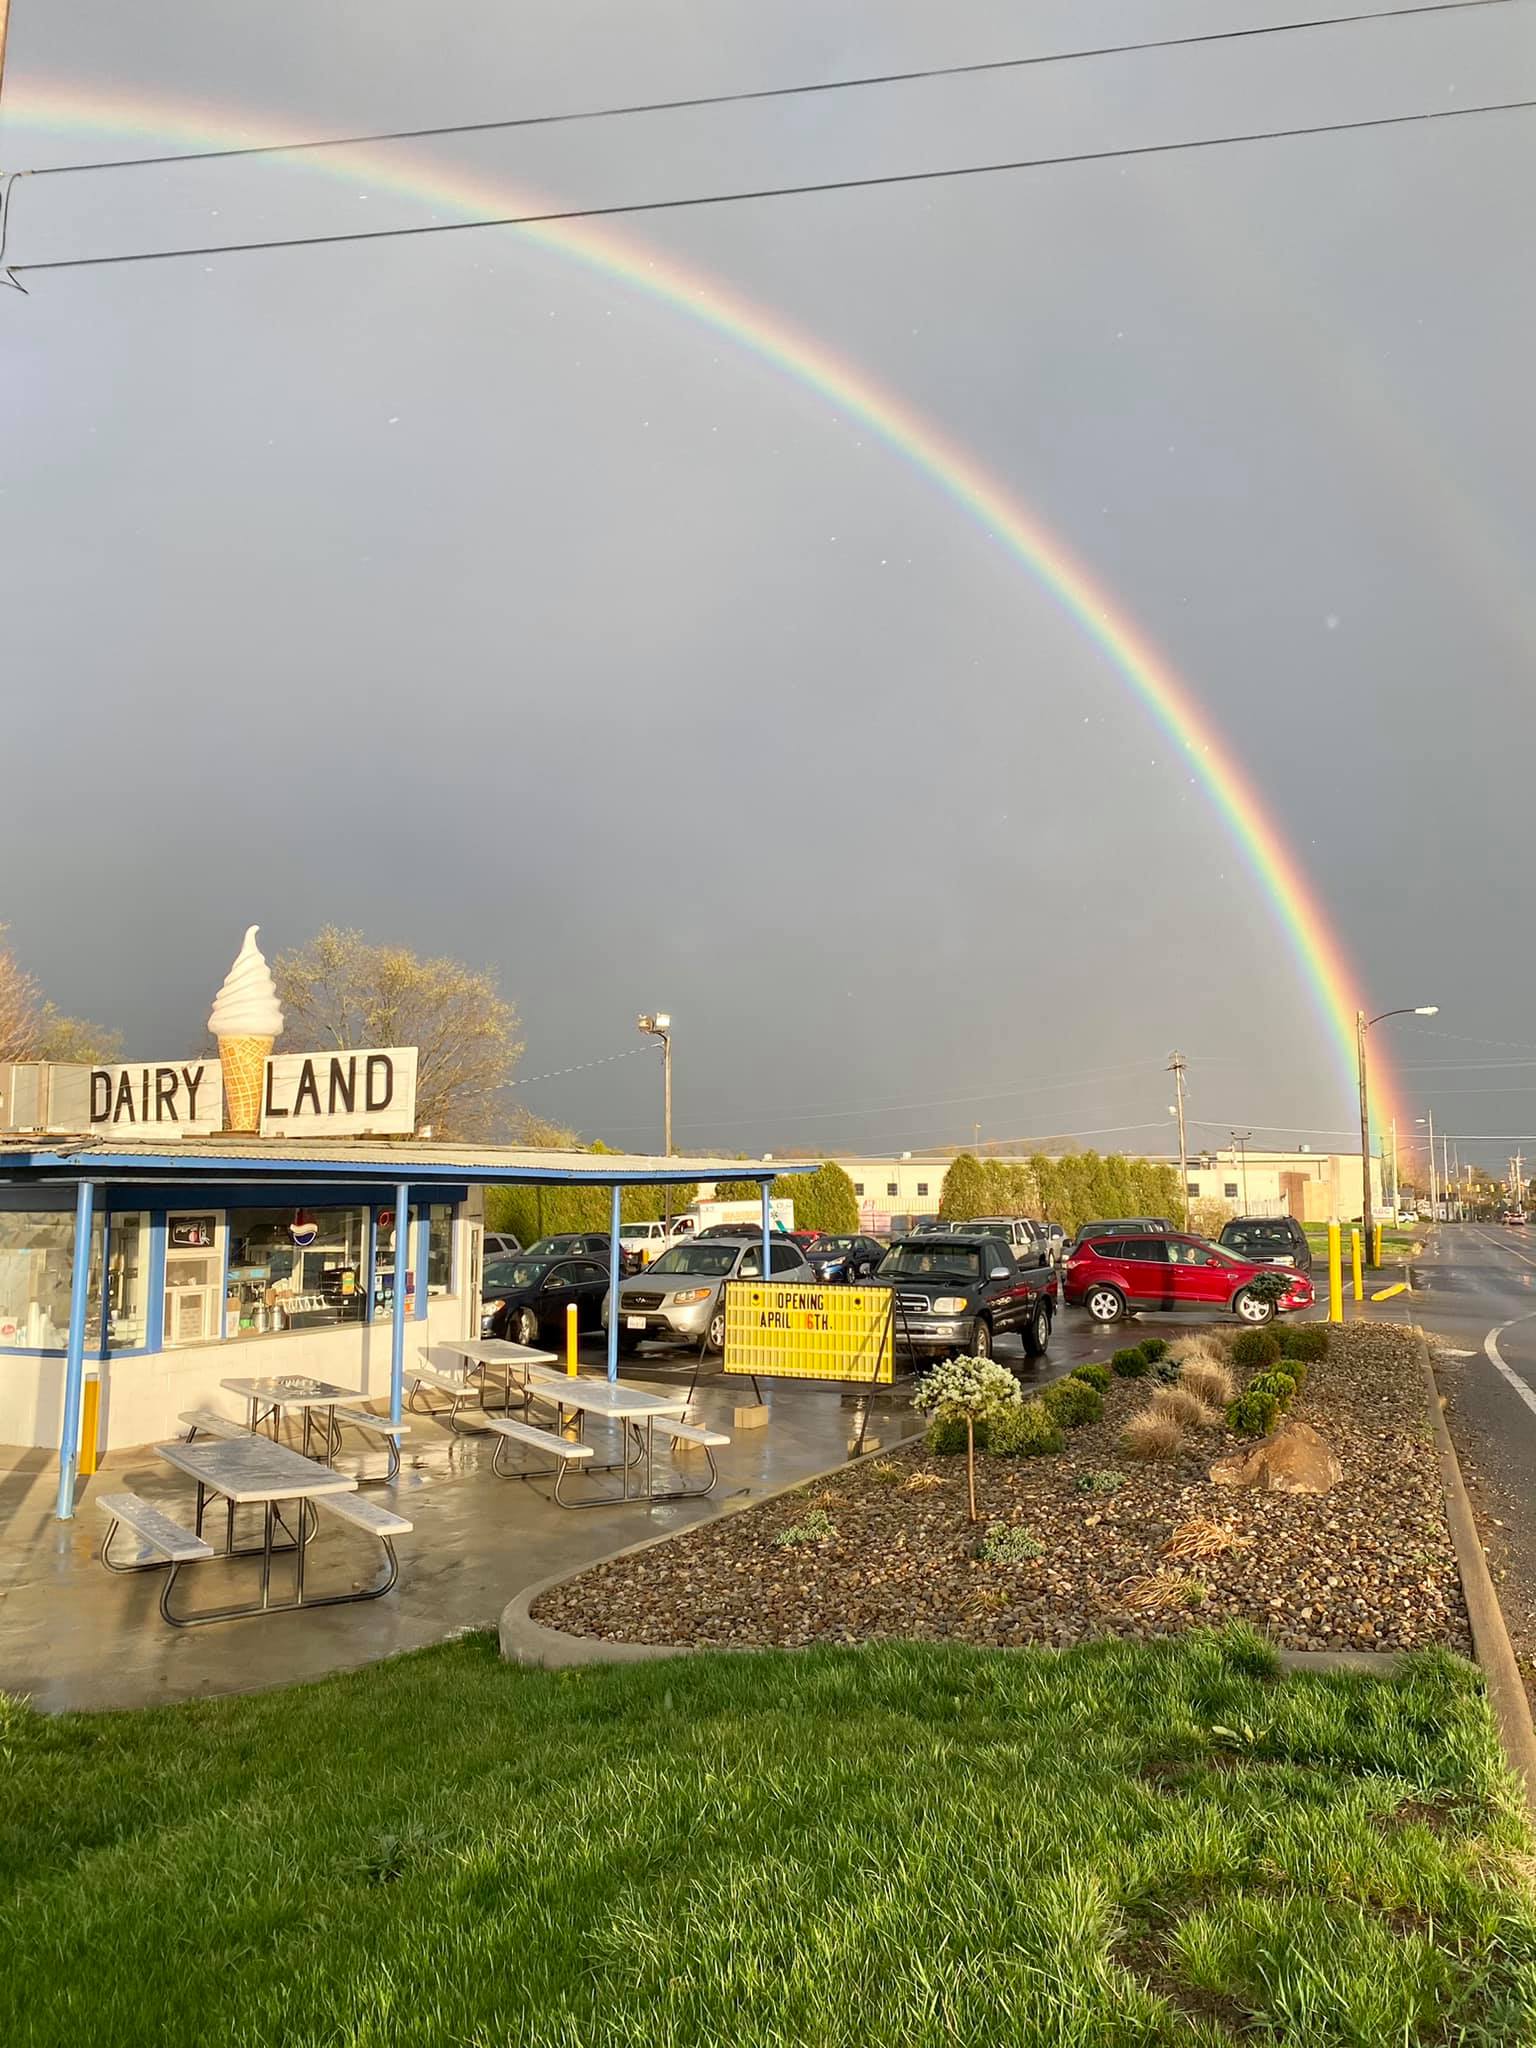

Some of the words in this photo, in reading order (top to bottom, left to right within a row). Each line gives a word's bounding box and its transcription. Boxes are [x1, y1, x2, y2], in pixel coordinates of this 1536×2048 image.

[90, 1066, 204, 1123] DAIRY
[264, 1054, 393, 1117] LAND
[777, 1292, 824, 1311] OPENING
[760, 1311, 791, 1329] APRIL
